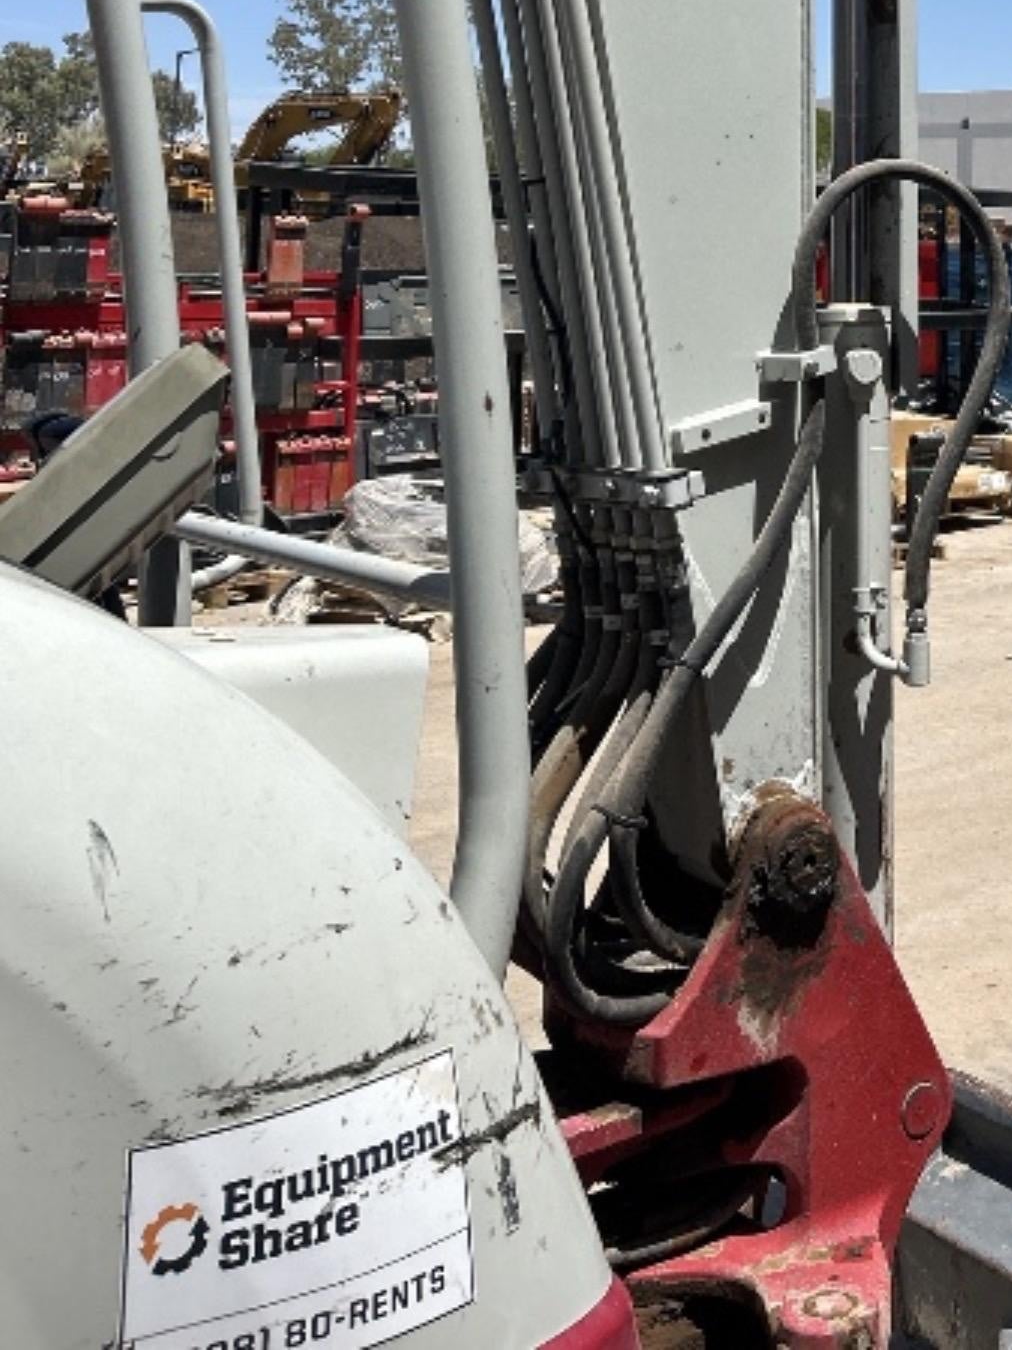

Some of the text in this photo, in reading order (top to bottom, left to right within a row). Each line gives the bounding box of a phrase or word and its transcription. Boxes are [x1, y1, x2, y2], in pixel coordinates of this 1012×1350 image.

[221, 1109, 453, 1223] Equipment
[218, 1202, 360, 1270] Share
[285, 1264, 445, 1348] 80-RENTS
